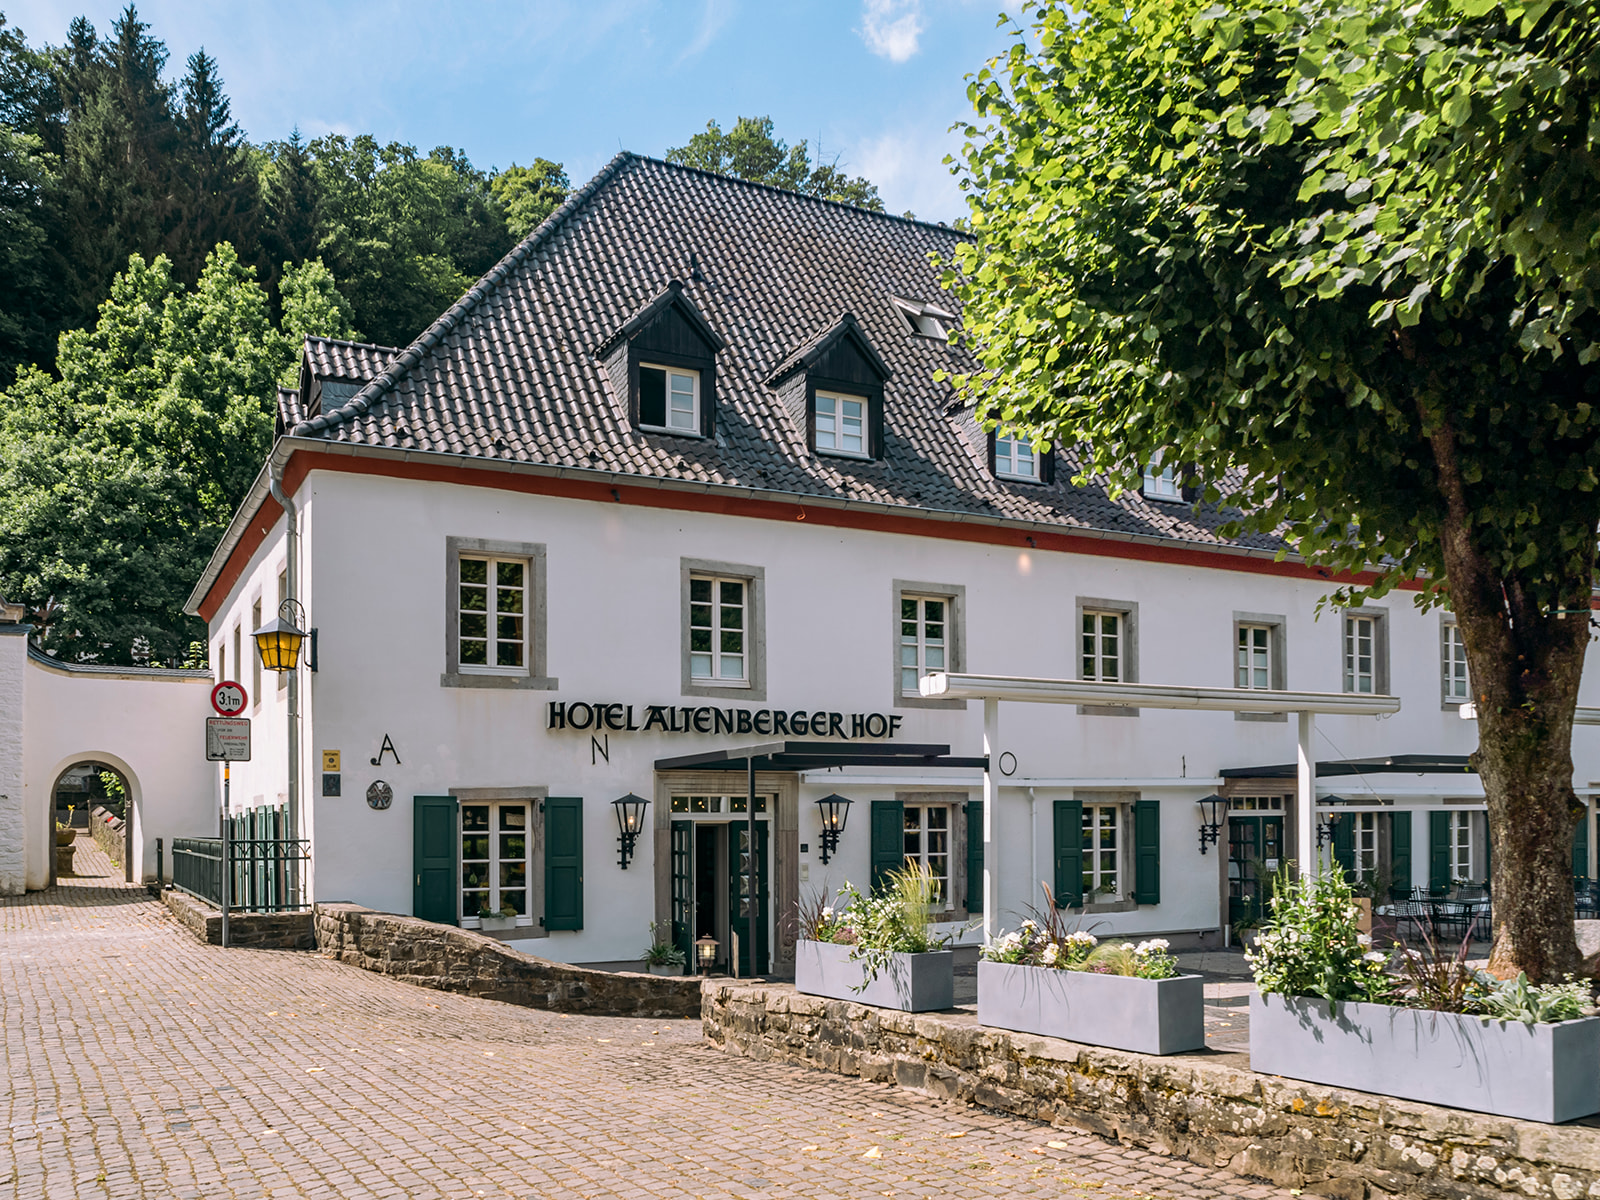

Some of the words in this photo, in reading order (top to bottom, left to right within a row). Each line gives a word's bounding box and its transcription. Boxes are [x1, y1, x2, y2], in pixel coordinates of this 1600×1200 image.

[548, 701, 640, 730] HOTEL
[643, 705, 849, 740] ALTENBERGER
[851, 713, 903, 739] HOF
